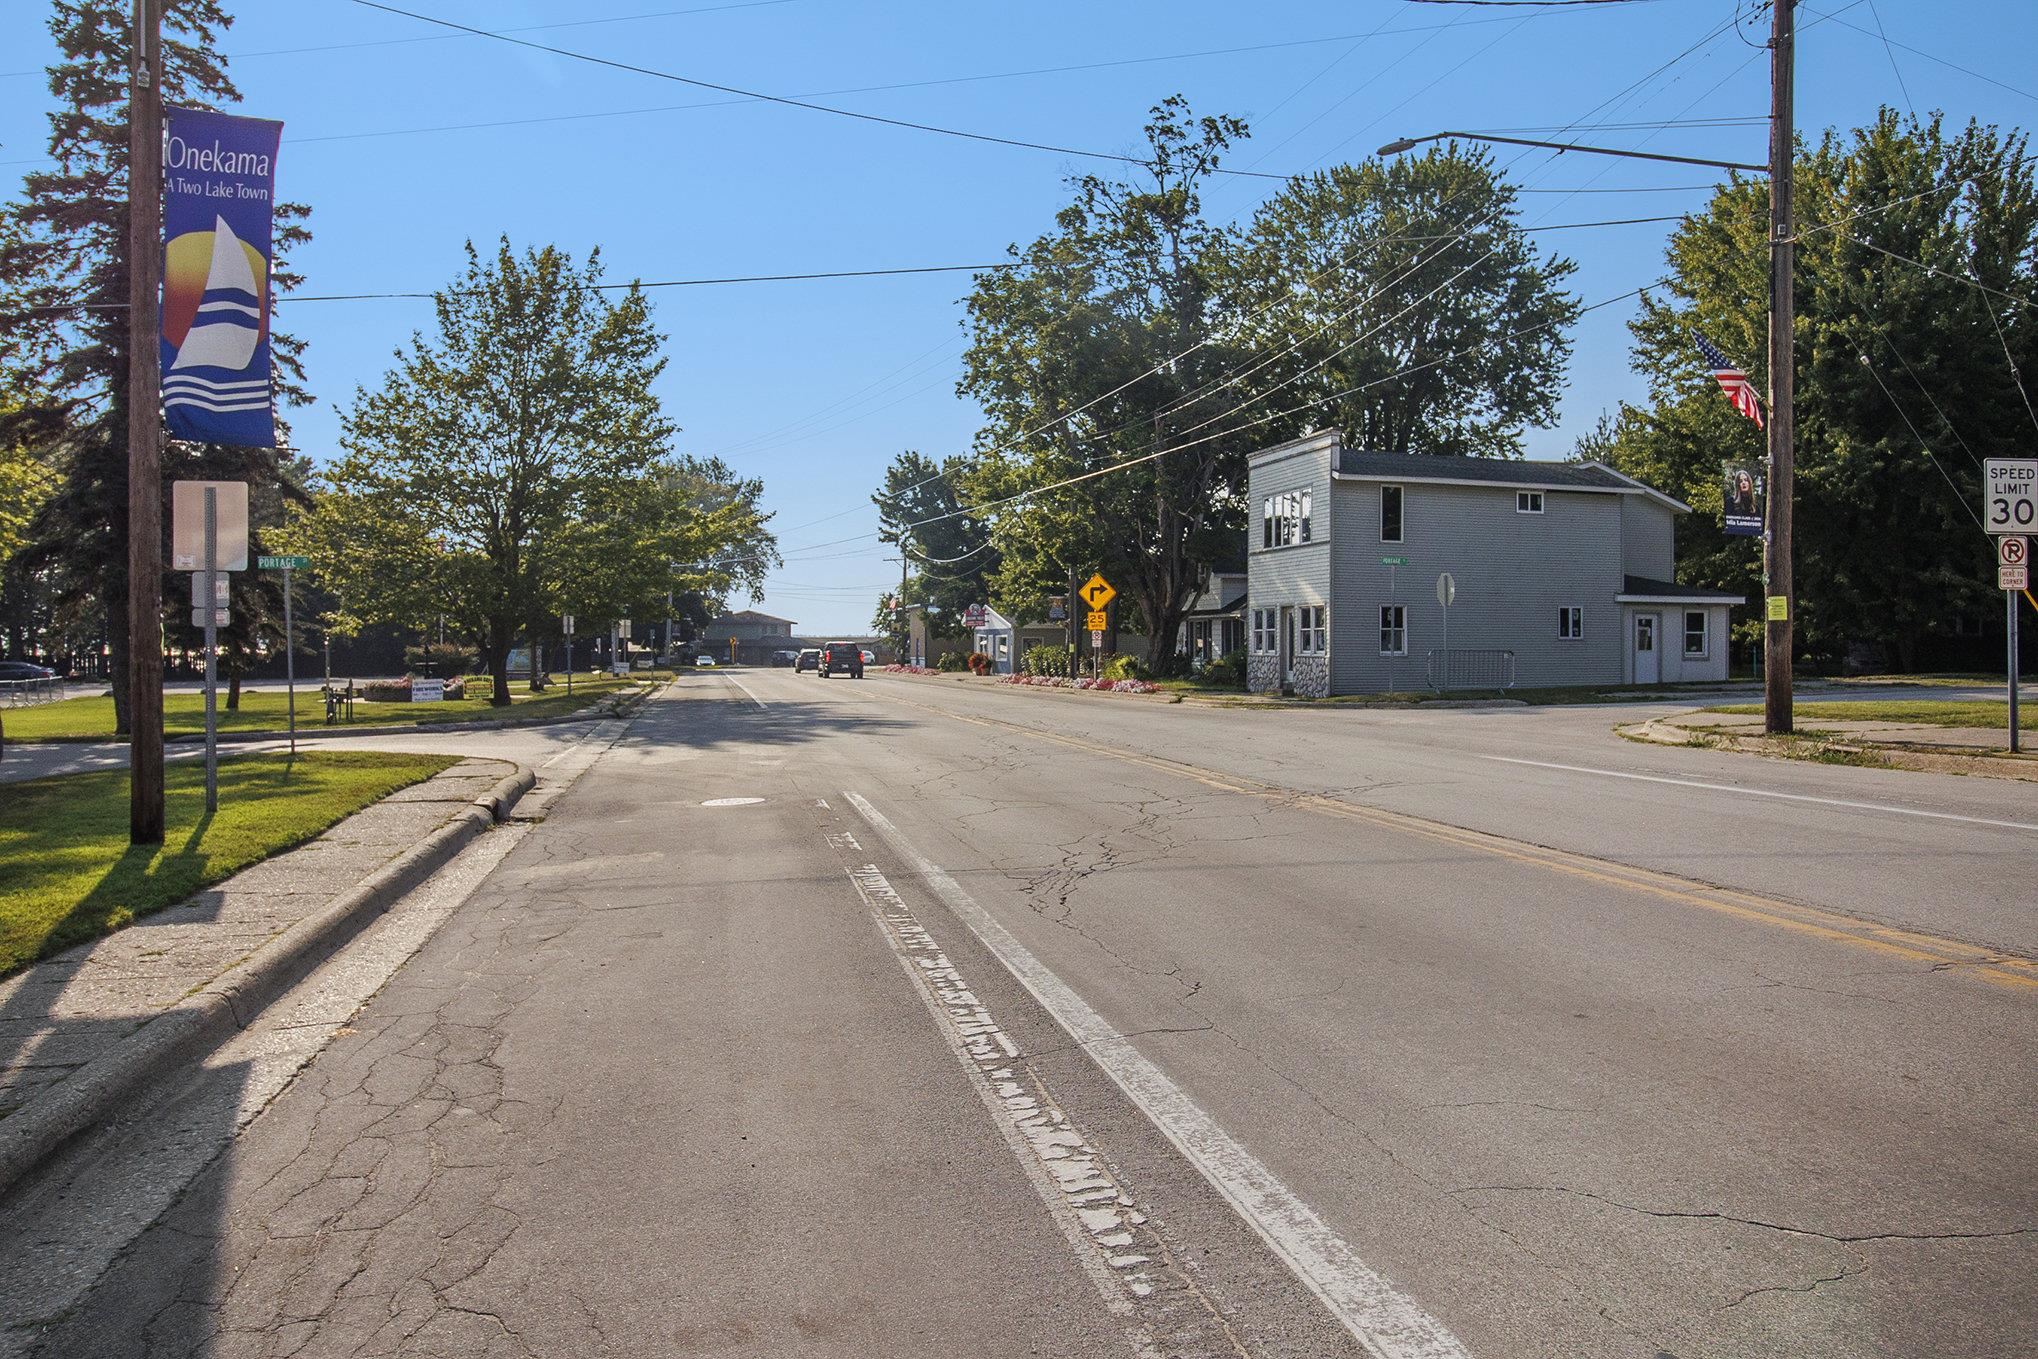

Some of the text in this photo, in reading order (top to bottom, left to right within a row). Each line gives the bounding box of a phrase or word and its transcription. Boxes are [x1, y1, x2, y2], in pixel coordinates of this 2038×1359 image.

[167, 136, 269, 177] Onekama
[166, 178, 268, 200] A Two Lake Town
[1990, 467, 2035, 480] SPEED
[1995, 483, 2030, 495] LIMIT
[1991, 498, 2034, 525] 30
[258, 558, 296, 568] PORTAGE
[2002, 570, 2016, 578] HERE
[2002, 577, 2024, 585] CORNER
[1089, 614, 1104, 623] 25
